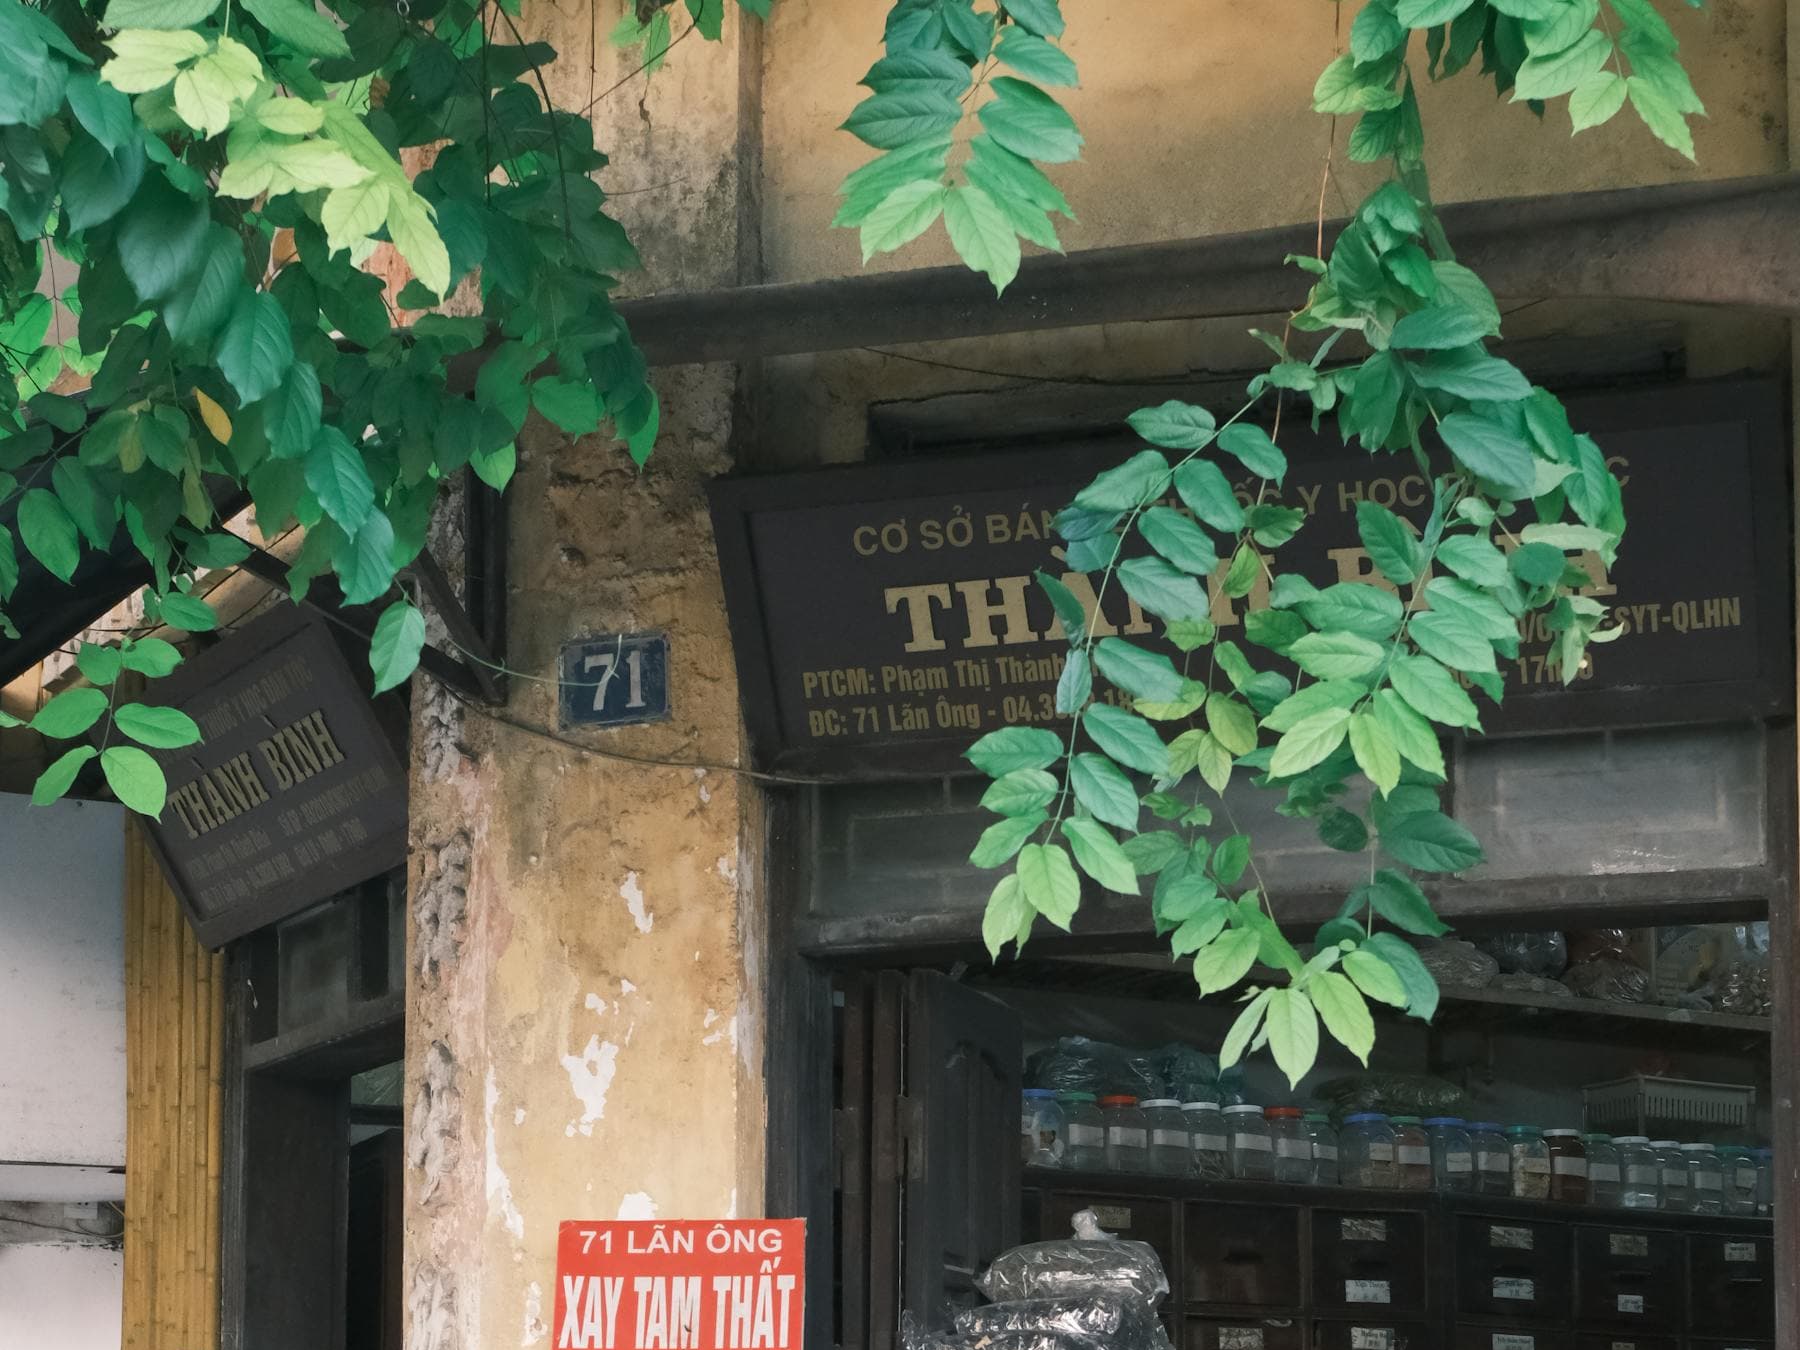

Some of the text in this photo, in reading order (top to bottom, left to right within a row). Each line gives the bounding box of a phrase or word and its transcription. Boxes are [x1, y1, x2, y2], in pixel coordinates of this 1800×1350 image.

[853, 519, 909, 556] CƠ
[920, 505, 973, 550] SỞ
[1297, 484, 1323, 516] Y
[584, 650, 647, 711] 71
[803, 668, 874, 698] PTCM:
[881, 664, 948, 697] Phạm
[954, 657, 989, 692] Thị
[808, 710, 849, 737] ĐC:
[853, 708, 880, 734] 71
[887, 704, 930, 733] Lãn
[935, 694, 982, 731] Ông
[580, 1224, 783, 1254] 71 LÃN ÔNG
[558, 1257, 796, 1349] XAY TAM THẤT
